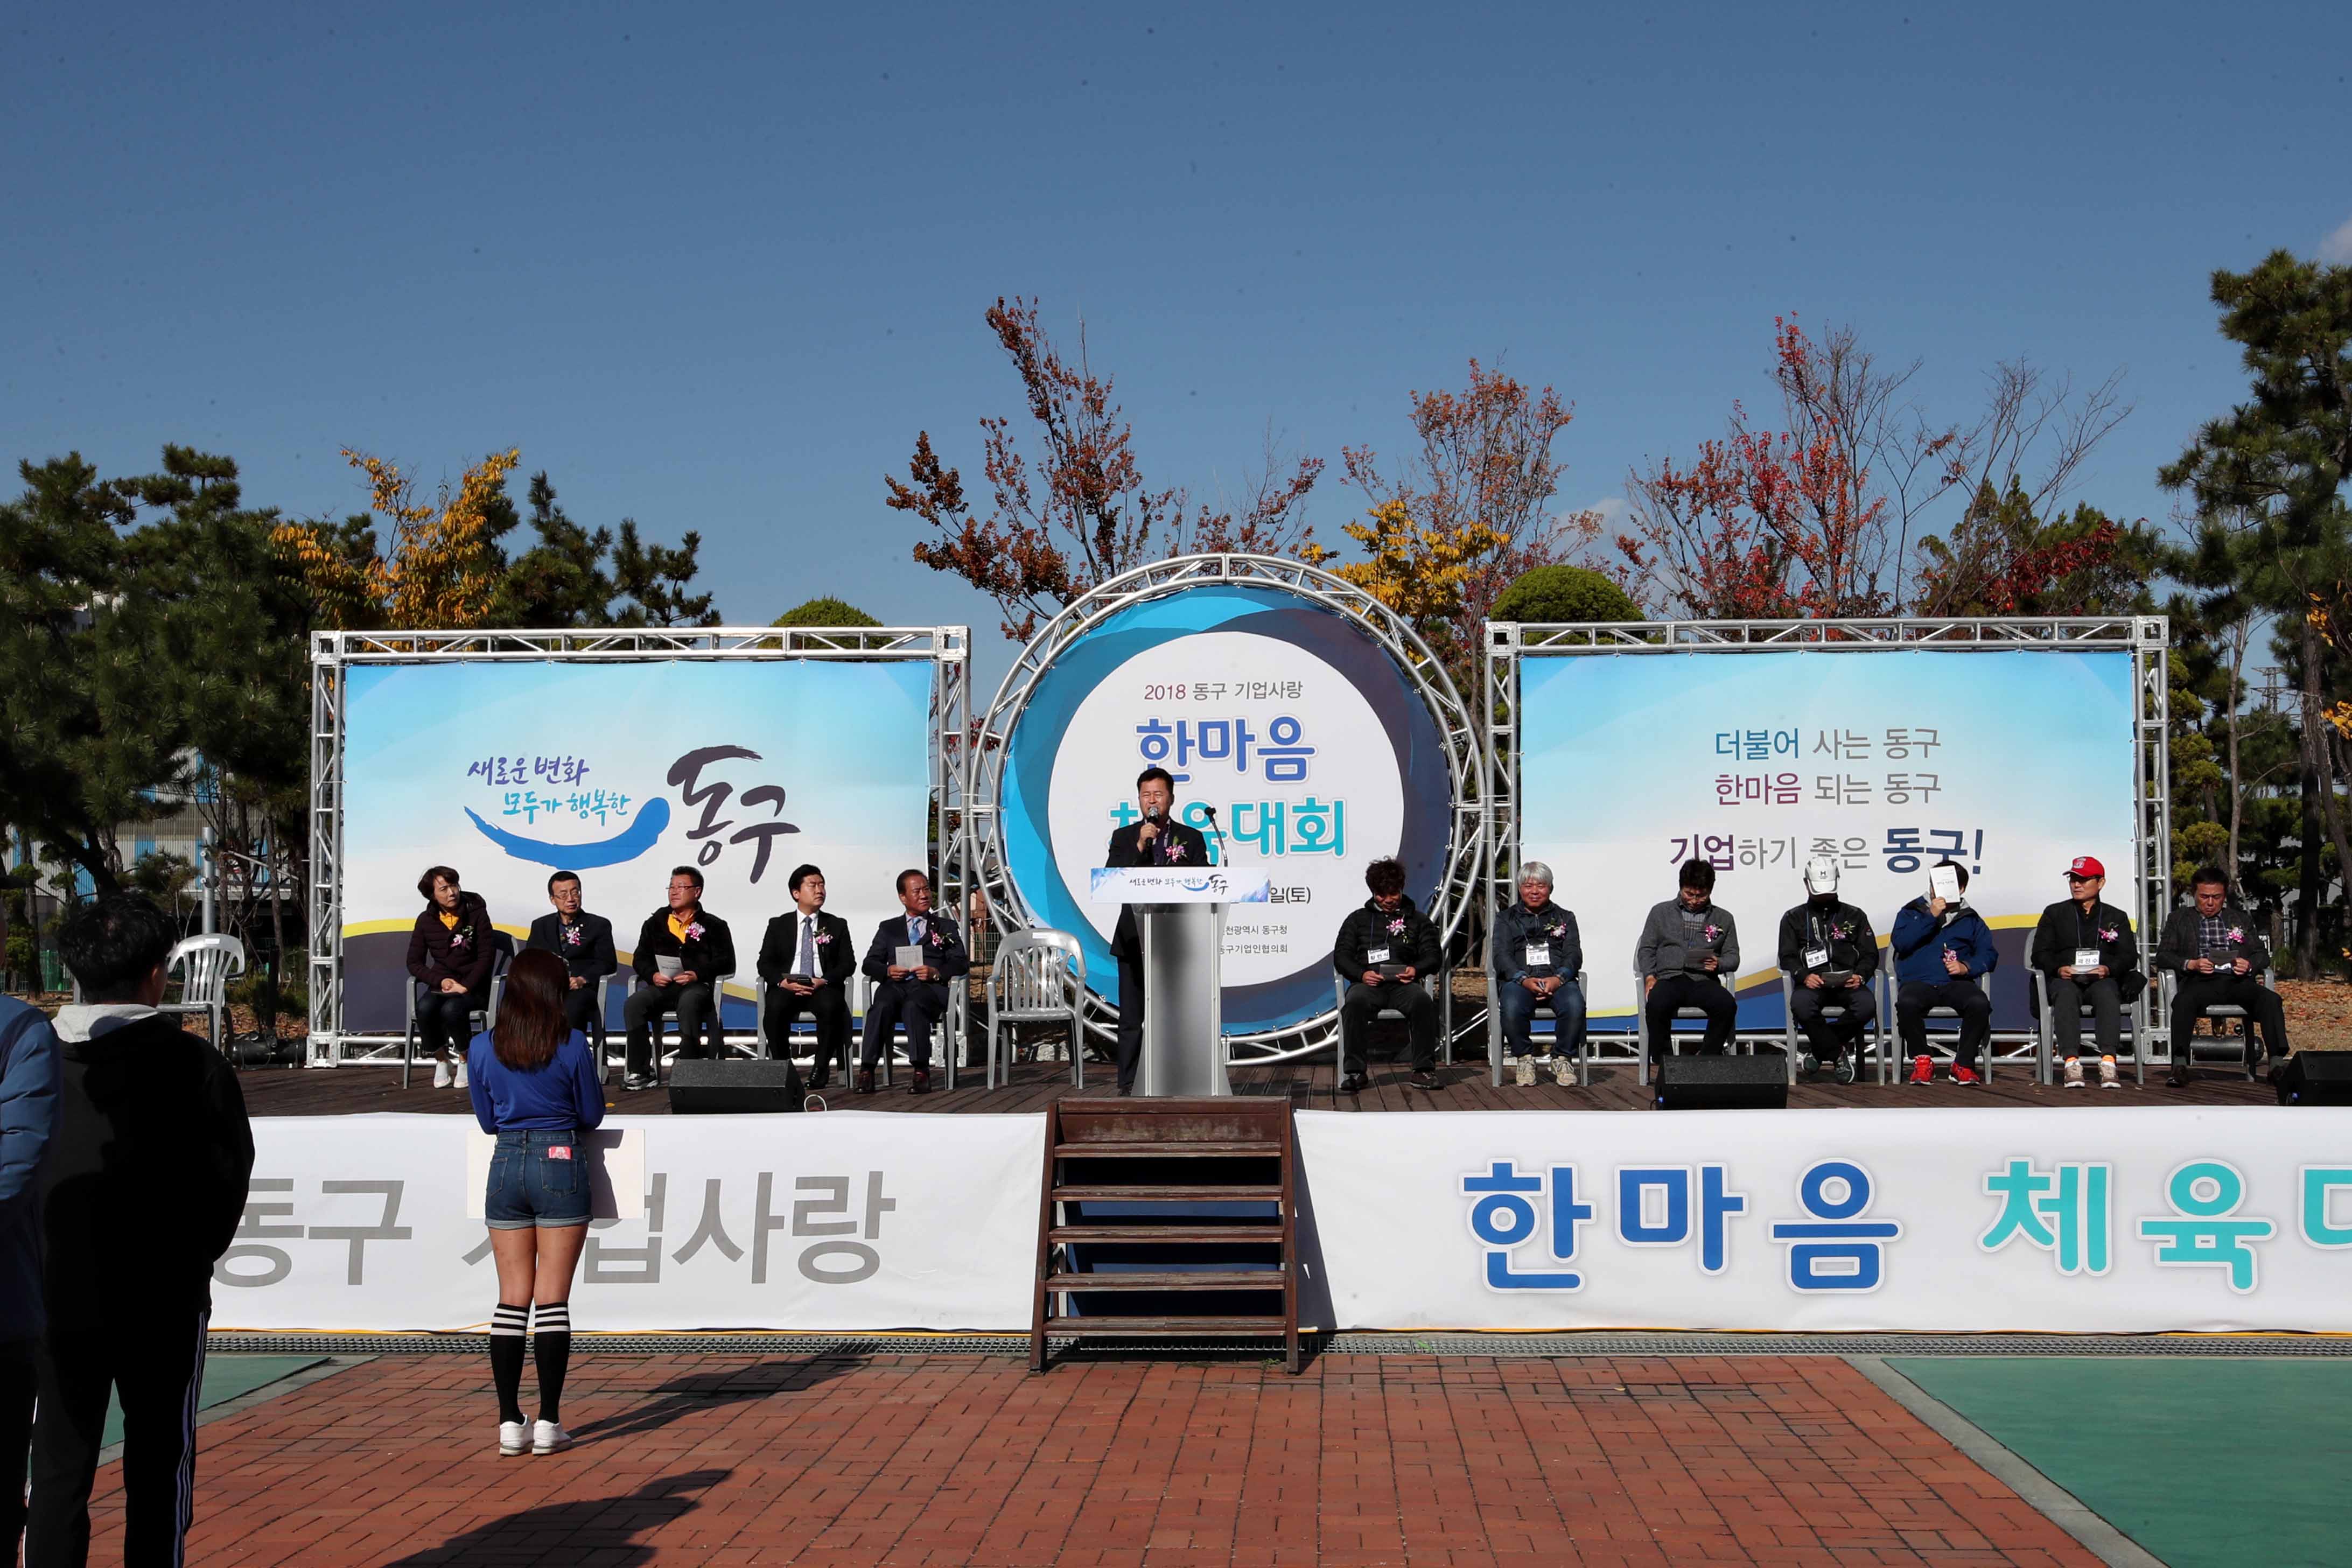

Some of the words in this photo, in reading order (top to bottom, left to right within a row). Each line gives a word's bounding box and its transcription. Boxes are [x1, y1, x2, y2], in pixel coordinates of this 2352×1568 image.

[1144, 684, 1186, 701] 2018
[1193, 681, 1227, 701] 동구
[1235, 680, 1303, 699] 기업사랑
[1135, 716, 1315, 782] 한마음
[1716, 728, 1800, 761] 더불어
[1812, 729, 1871, 760] 사는
[1883, 728, 1941, 760] 동구
[467, 755, 529, 786] 새로운
[534, 755, 590, 787] 변화
[1715, 772, 1802, 806] 한마음
[1814, 773, 1872, 805] 되는
[1884, 773, 1941, 804] 동구
[502, 790, 563, 825] 모두가
[565, 788, 631, 827] 행복한
[667, 745, 800, 884] 동구
[1670, 834, 1796, 871] 기업하기
[1882, 827, 1984, 874] 동구!
[1208, 873, 1229, 895] 동구
[1223, 925, 1259, 935] 천광역시
[1262, 925, 1287, 935] 동구청
[212, 1178, 412, 1288] 동구
[462, 1171, 896, 1285] 업사랑
[1464, 1160, 1898, 1290] 한마음
